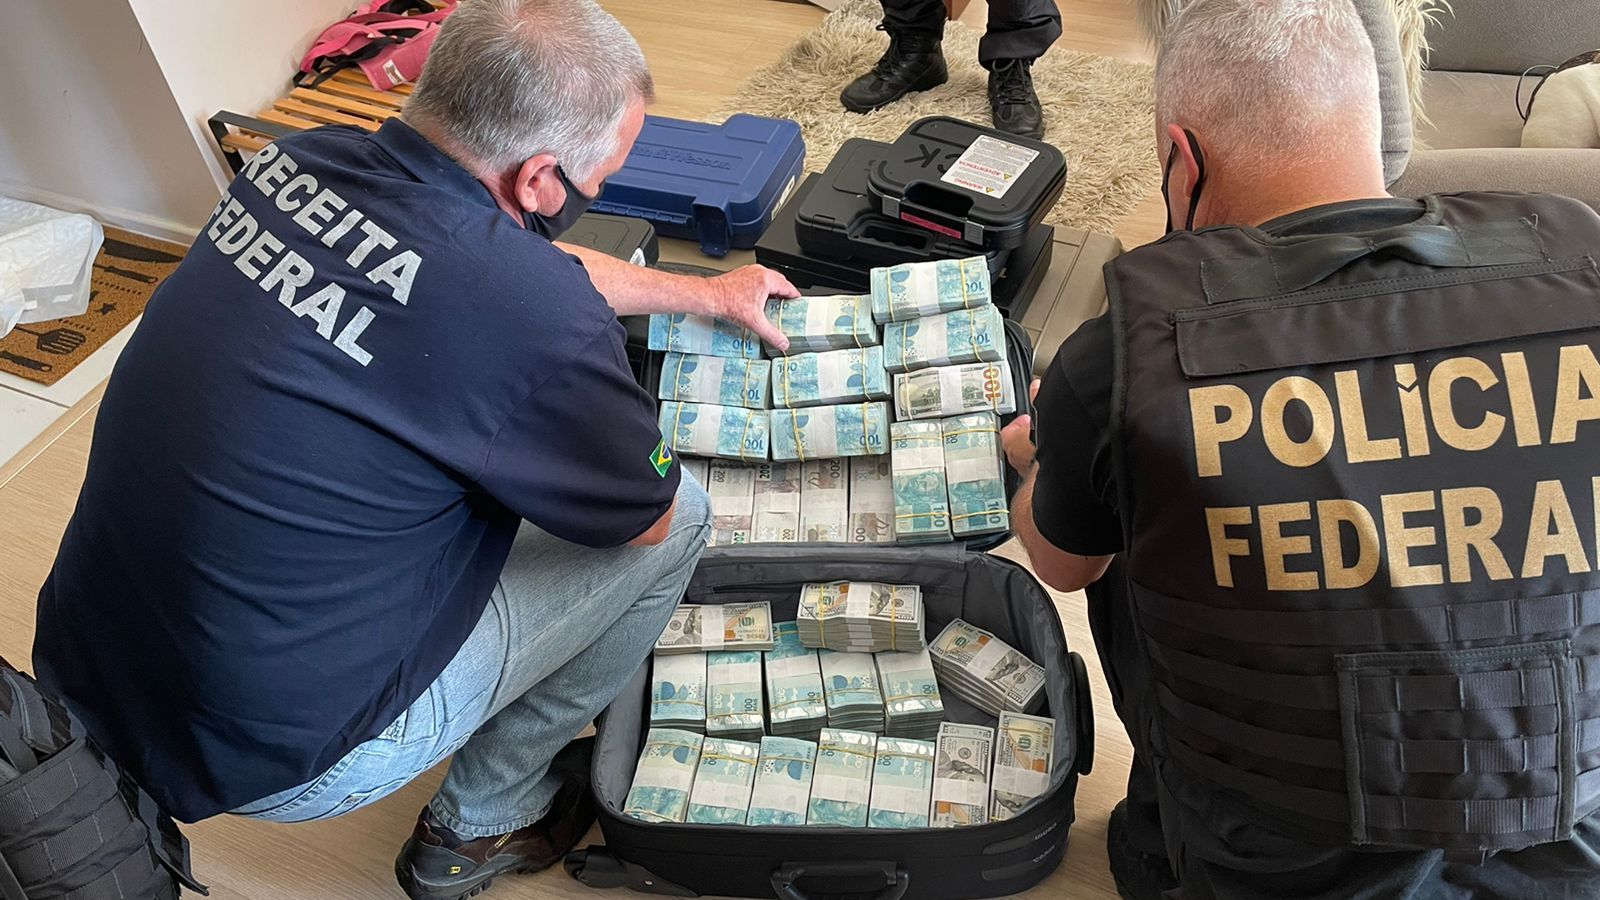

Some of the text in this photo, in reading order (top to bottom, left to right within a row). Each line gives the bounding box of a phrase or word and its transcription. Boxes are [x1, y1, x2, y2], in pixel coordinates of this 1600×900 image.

[954, 177, 984, 190] WARNING
[240, 143, 423, 306] RECEITA
[769, 302, 790, 311] 100
[732, 338, 753, 351] 100
[968, 332, 990, 346] 100
[982, 367, 1002, 402] 100
[739, 388, 760, 401] 100
[743, 438, 764, 451] 100
[859, 434, 882, 447] 100
[759, 464, 770, 480] 200
[830, 459, 841, 478] 200
[717, 470, 726, 483] 200
[933, 504, 946, 528] 100
[987, 500, 1002, 524] 100
[782, 528, 791, 541] 200
[855, 527, 866, 542] 00
[1205, 476, 1600, 590] FEDERA
[744, 698, 753, 712] 100
